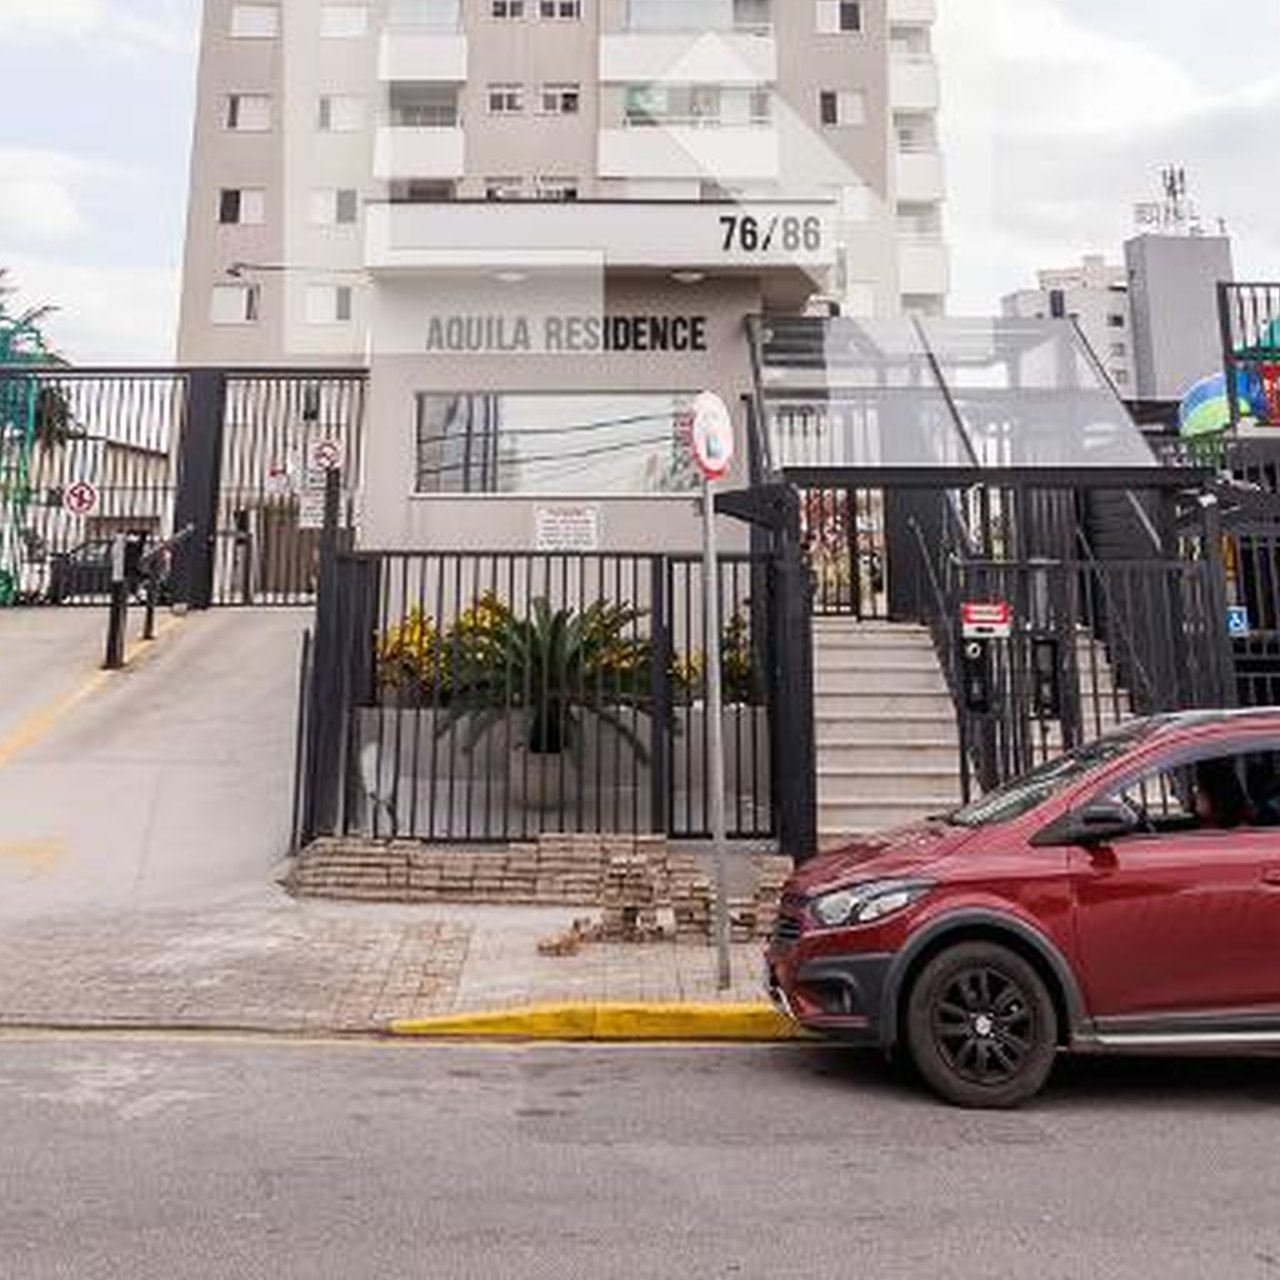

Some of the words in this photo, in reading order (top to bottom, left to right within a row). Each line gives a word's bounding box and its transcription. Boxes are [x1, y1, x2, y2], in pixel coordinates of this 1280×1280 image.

[719, 216, 820, 251] 76/86
[426, 316, 531, 351] AQUILA
[545, 316, 708, 351] RESIDENCE
